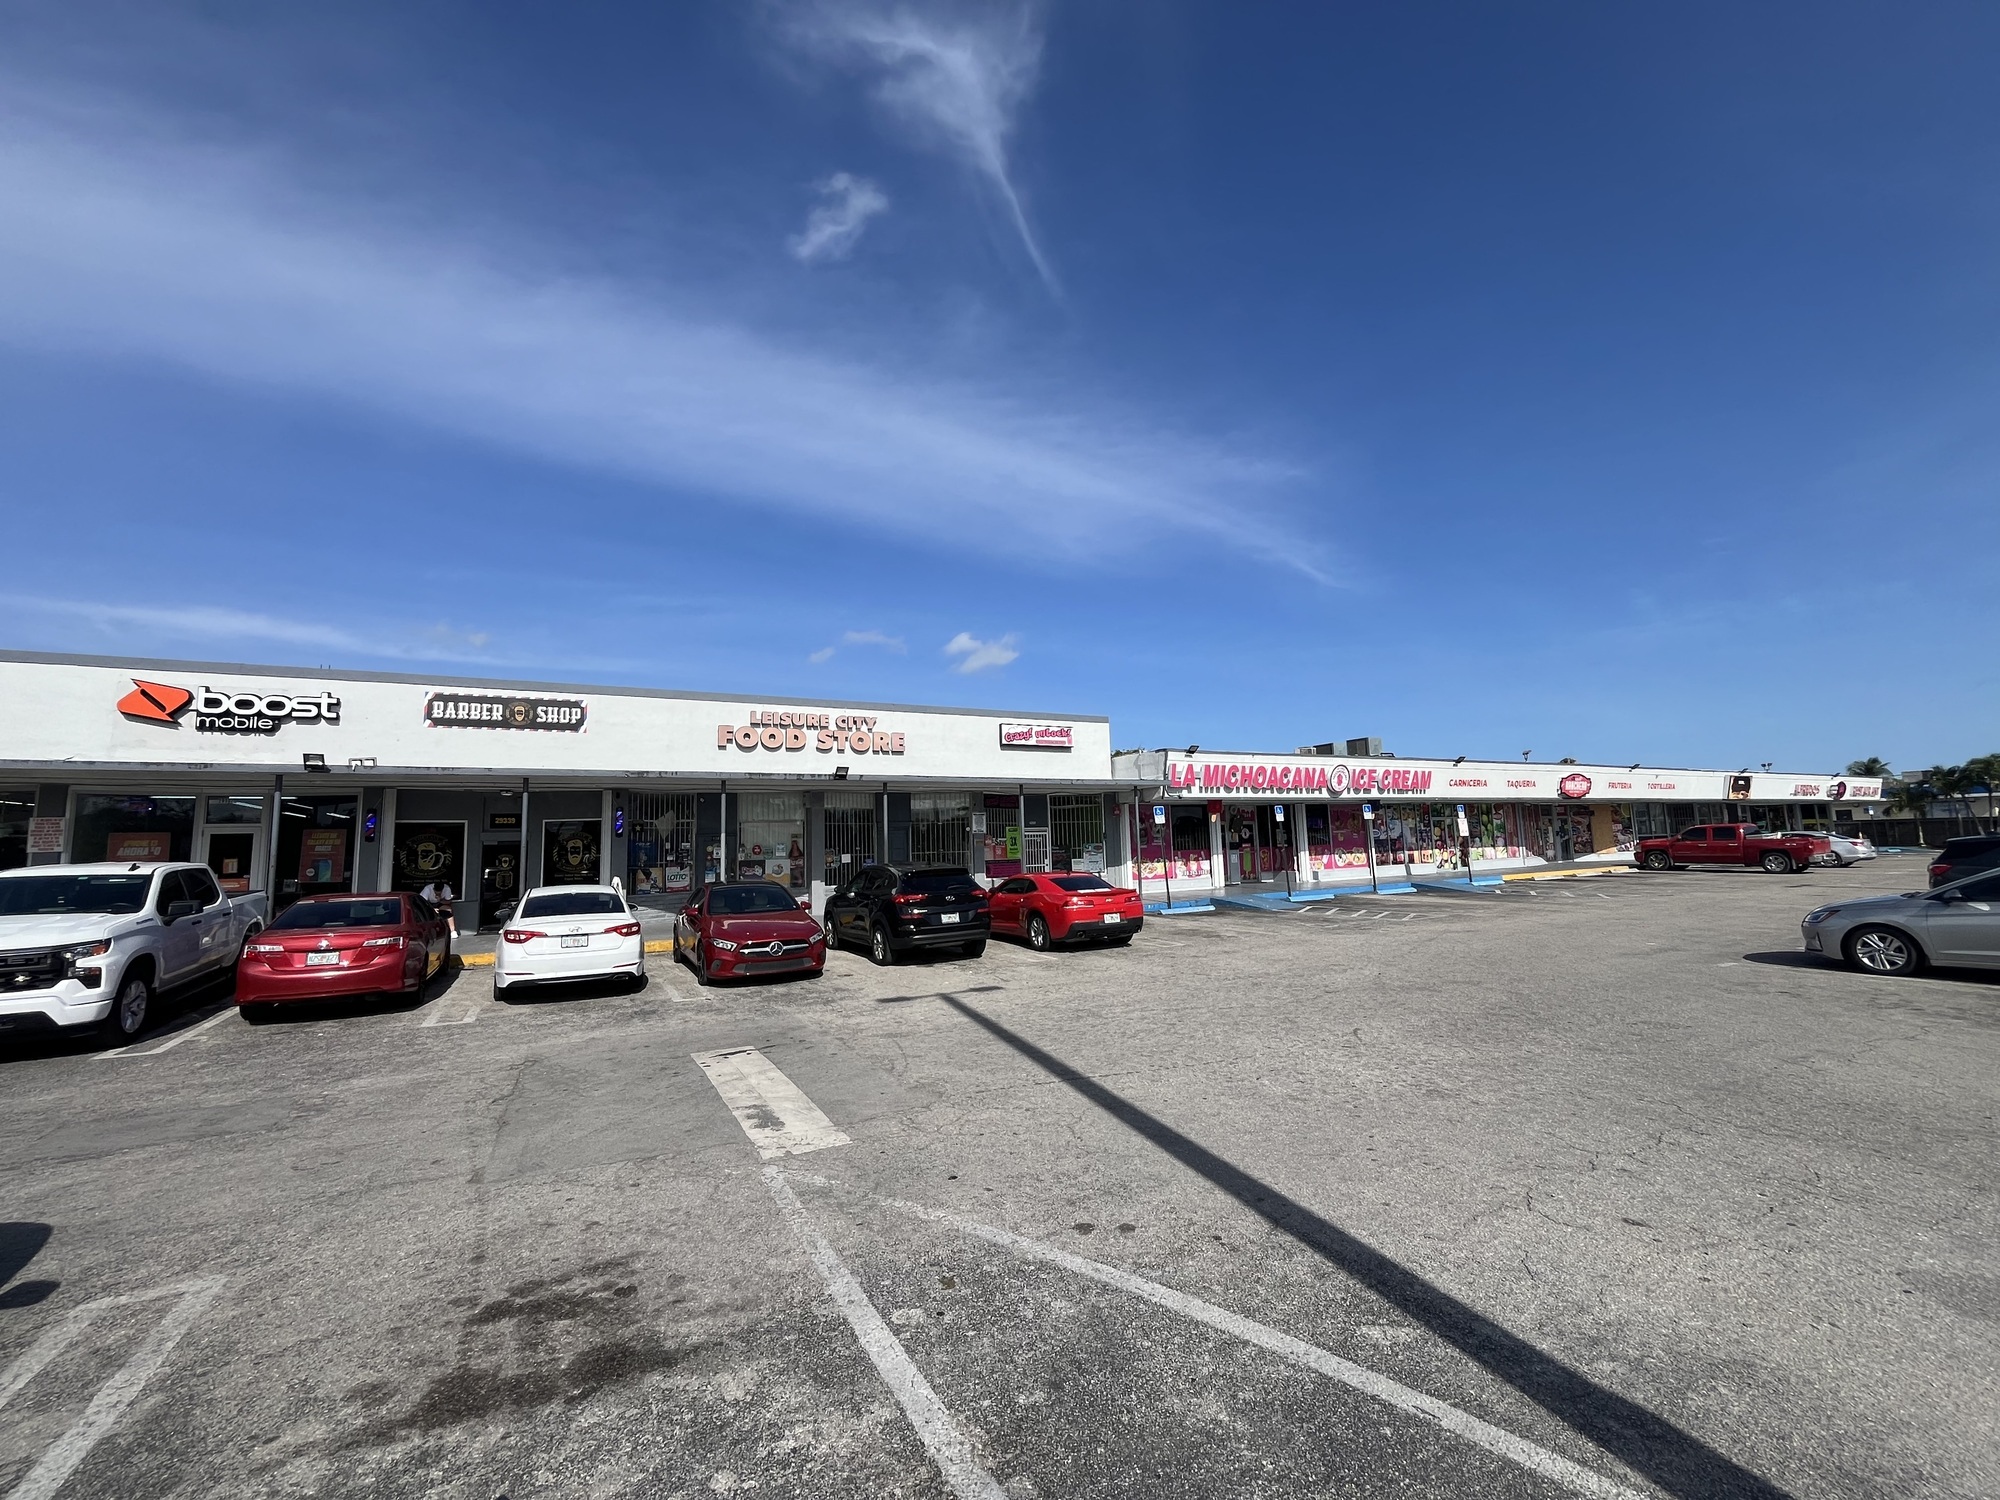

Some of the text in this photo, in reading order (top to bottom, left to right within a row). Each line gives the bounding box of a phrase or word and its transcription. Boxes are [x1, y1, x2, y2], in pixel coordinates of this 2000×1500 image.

[197, 685, 340, 719] boost
[431, 701, 582, 724] BARBER SHOP
[750, 710, 878, 731] LEISURE CITY
[196, 715, 275, 731] mobile
[717, 725, 906, 753] FOOD STORE
[1170, 763, 1196, 788] LA
[1202, 764, 1327, 790] MICHOACANA
[1351, 767, 1378, 790] ICE
[1380, 768, 1433, 791] CREAM
[1448, 778, 1488, 788] CARNICERIA
[1506, 780, 1537, 789] TAQUERIA
[1607, 782, 1632, 790] FRUTERIA
[666, 872, 687, 881] LOTTO
